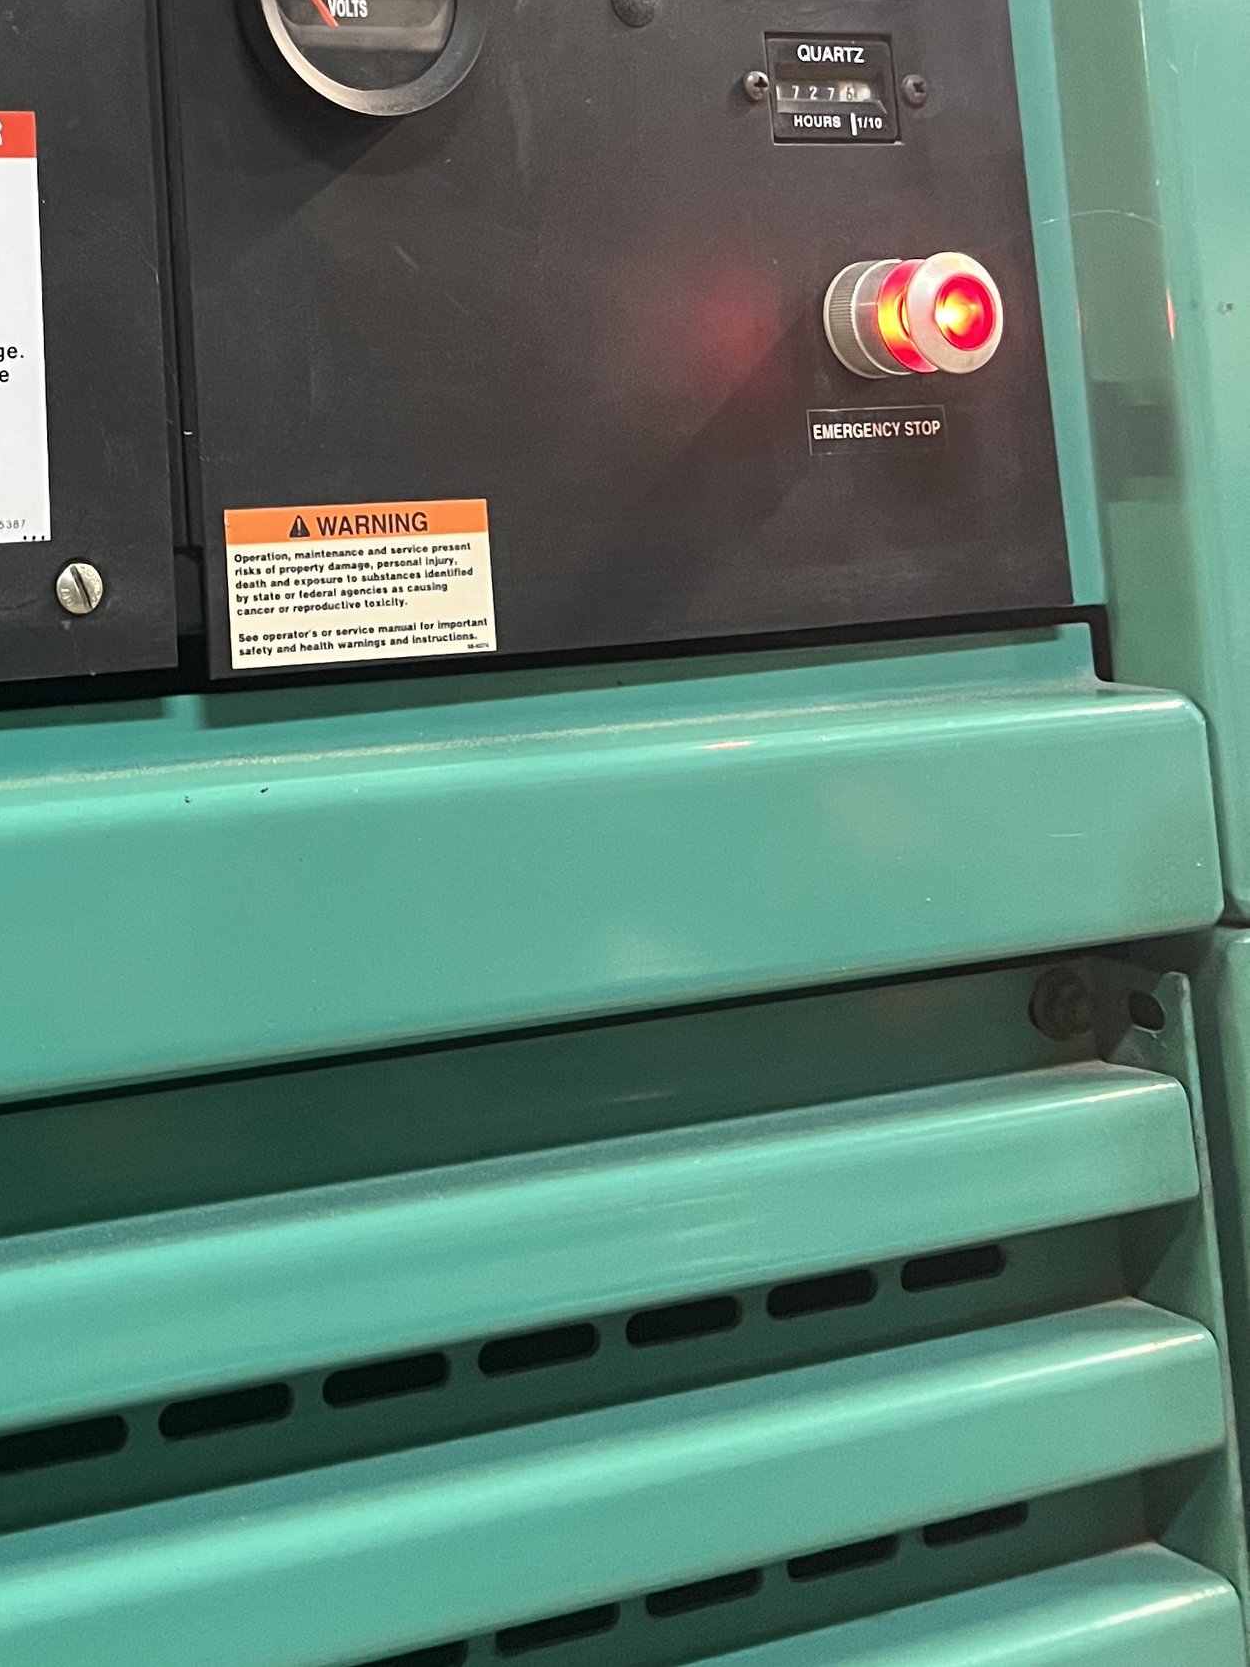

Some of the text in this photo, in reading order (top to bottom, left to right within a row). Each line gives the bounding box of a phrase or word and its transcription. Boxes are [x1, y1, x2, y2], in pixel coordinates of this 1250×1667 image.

[797, 44, 865, 63] QUARTZ
[793, 115, 883, 129] HOURS 1/10
[812, 420, 941, 440] EMERGENCY STOP
[316, 511, 428, 536] WARNING
[234, 542, 471, 564] Operation, maintenance and service present
[234, 556, 458, 576] risks of property damage, personal injury,
[235, 567, 473, 590] death and exposure to substances identified
[236, 582, 448, 605] by state or federal agencies as causing
[236, 597, 408, 616] cancer or reproductive toxicity.
[238, 617, 488, 643] See operator's or service manual for important
[239, 632, 478, 656] safety and health warnings and instructions.
